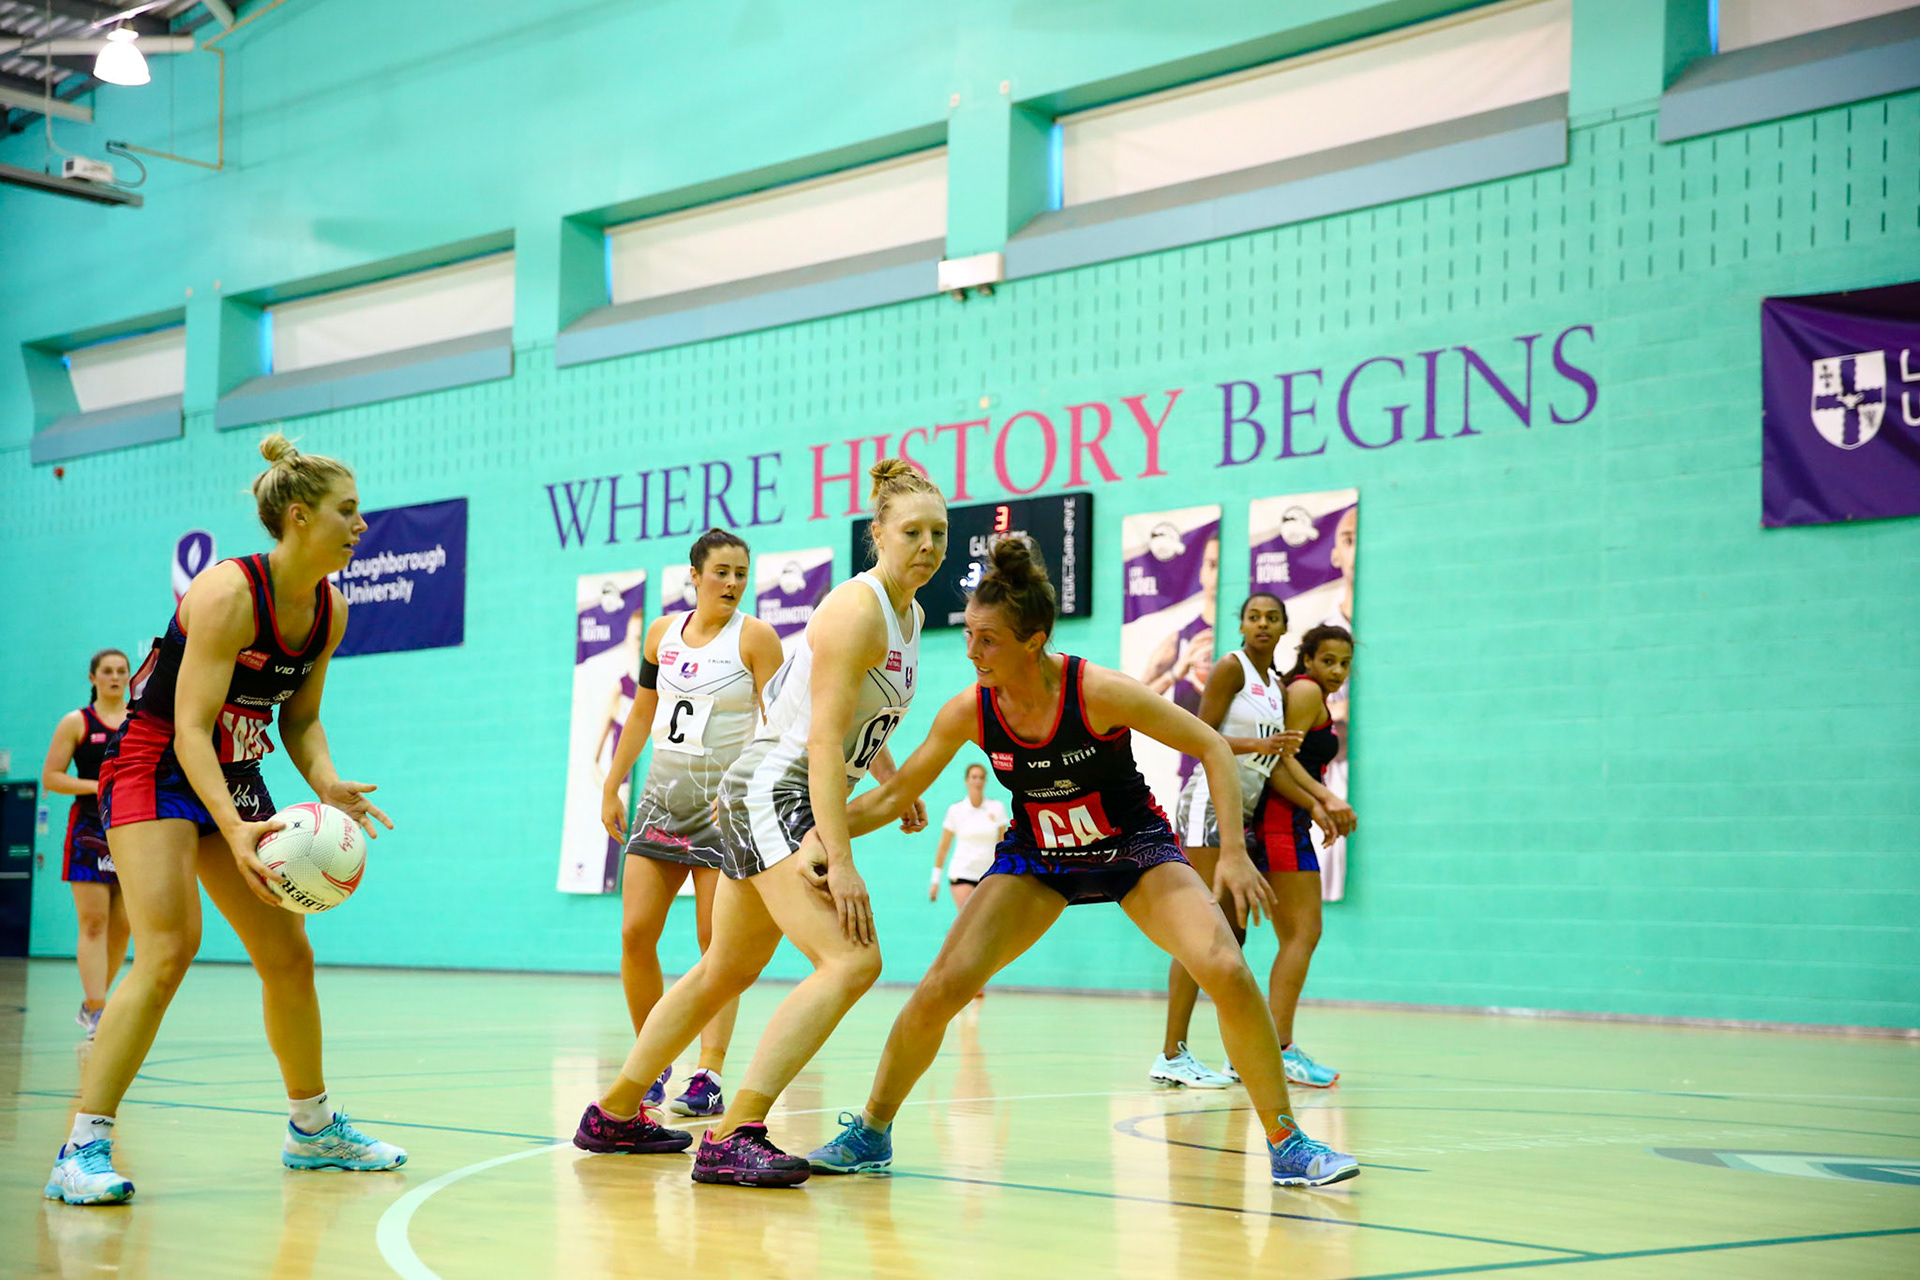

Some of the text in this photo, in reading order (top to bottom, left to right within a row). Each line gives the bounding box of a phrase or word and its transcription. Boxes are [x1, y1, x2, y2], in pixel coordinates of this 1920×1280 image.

[544, 453, 787, 551] WHERE
[1214, 325, 1599, 469] BEGINS
[994, 505, 1010, 532] 3
[342, 543, 447, 581] Loughborough
[343, 576, 415, 606] University
[667, 699, 694, 744] C
[1027, 786, 1081, 798] Strathclyde
[1038, 804, 1110, 849] GA
